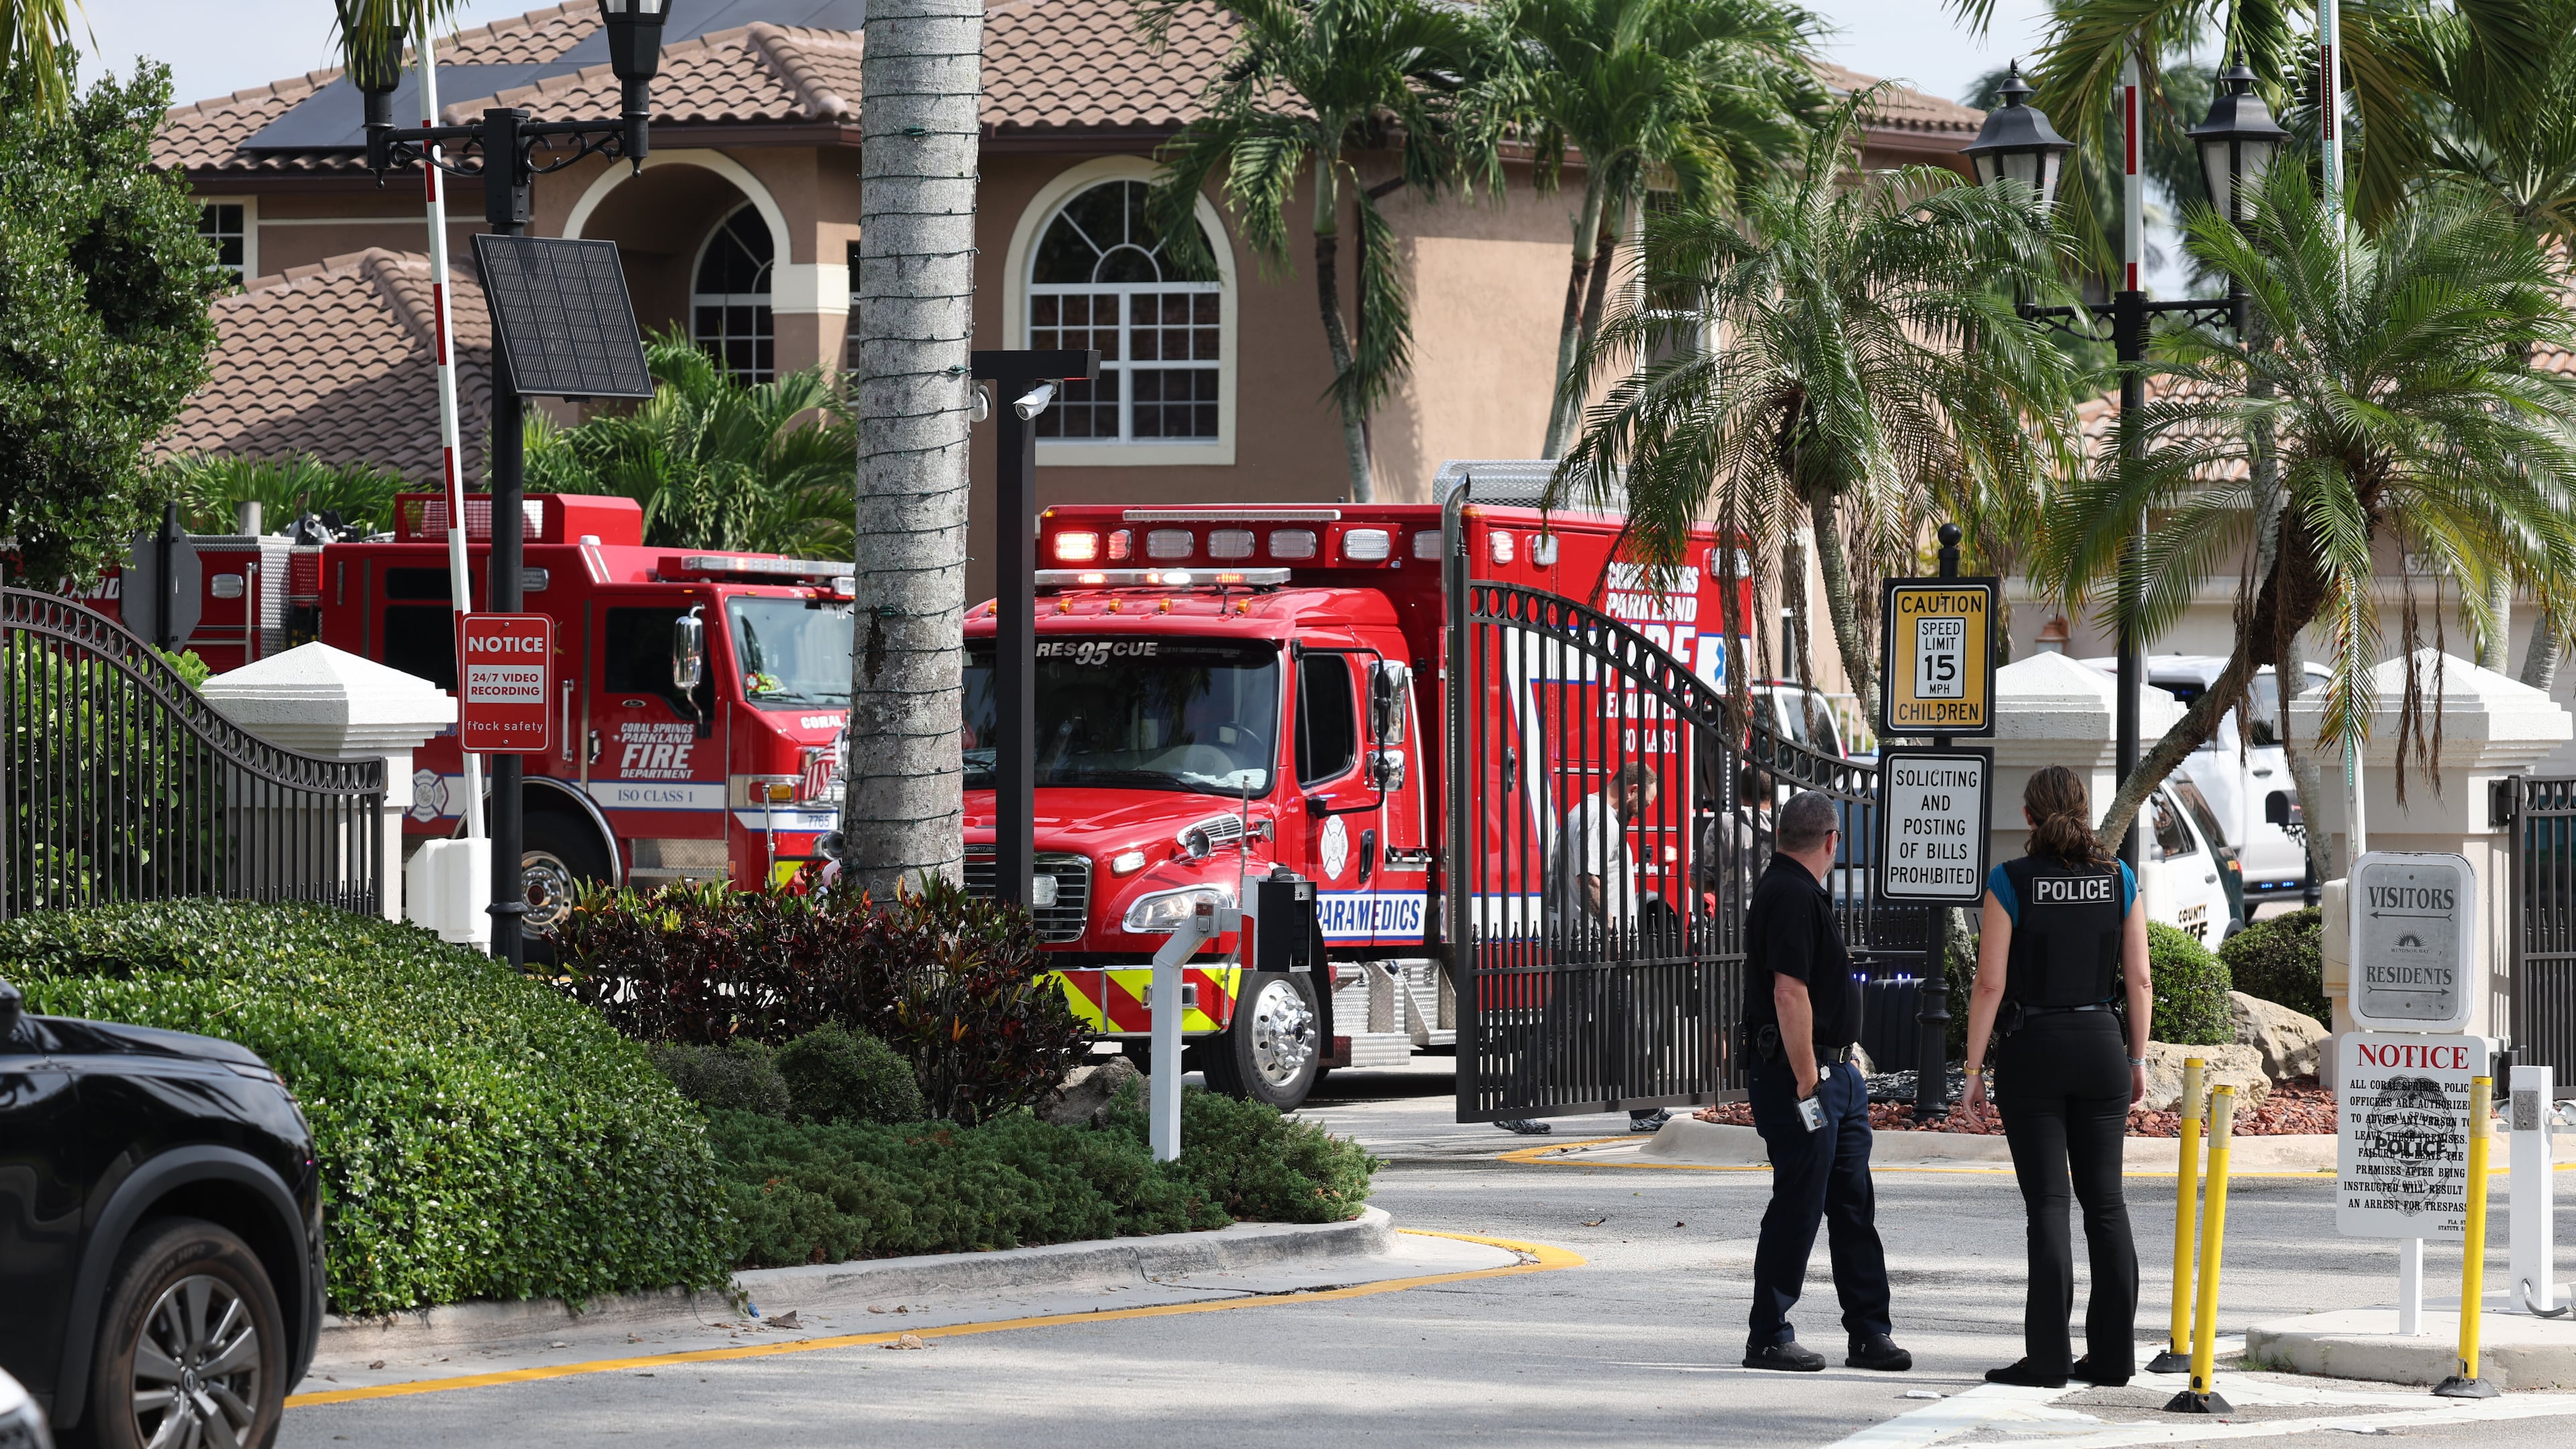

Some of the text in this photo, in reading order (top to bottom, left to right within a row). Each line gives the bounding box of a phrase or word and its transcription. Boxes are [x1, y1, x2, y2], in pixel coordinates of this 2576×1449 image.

[1605, 592, 1698, 623] PARKLAND
[1901, 596, 1982, 613] CAUTION
[1922, 622, 1960, 635] SPEED
[468, 637, 544, 653] NOTICE
[1925, 637, 1956, 650] LIMIT
[1925, 655, 1955, 681] 15
[472, 673, 539, 683] 24/7 VIDEO
[471, 686, 540, 696] RECORDING
[1929, 684, 1950, 694] MPH
[1898, 703, 1979, 720] CHILDREN
[504, 721, 543, 733] safety
[621, 722, 694, 733] CORAL SPRINGS
[800, 715, 843, 729] CORAL
[621, 733, 694, 744] PARKLAND
[620, 743, 694, 769] FIRE
[620, 769, 694, 779] DEPARTMENT
[1896, 769, 1977, 788] SOLICITING
[618, 790, 693, 802] ISO CLASS 1
[1921, 794, 1951, 811] AND
[808, 815, 830, 828] 7765
[1904, 818, 1966, 836] POSTING
[1900, 843, 1967, 859] OF BILLS
[1890, 867, 1974, 884] PROHIBITED
[2038, 879, 2110, 900] POLICE
[2368, 886, 2454, 910] VISITORS
[1316, 899, 1420, 931] PARAMEDICS
[2178, 904, 2207, 924] COUNTY
[2367, 966, 2452, 985] RESIDENTS
[2357, 1044, 2469, 1069] NOTICE
[2350, 1079, 2469, 1093] ALL CORAL SPRINGS POLIC
[2350, 1096, 2392, 1107] OFFICERS
[2396, 1098, 2414, 1108] ARE
[2351, 1114, 2361, 1123] TO
[2365, 1114, 2397, 1124] ADVISE
[2402, 1115, 2418, 1125] ANY
[2423, 1116, 2457, 1127] PERSON
[2355, 1130, 2467, 1144] LEAVE THESE PREMISES.
[2375, 1135, 2447, 1157] POLICE
[2358, 1148, 2463, 1161] FAILURE TO LEAVE THE
[2356, 1165, 2465, 1178] PREMISES AFTER BEING
[2344, 1181, 2463, 1195] INSTRUCTED WILL RESULT
[2348, 1198, 2360, 1208] AN
[2364, 1199, 2400, 1210] ARREST
[2404, 1200, 2420, 1211] FOR
